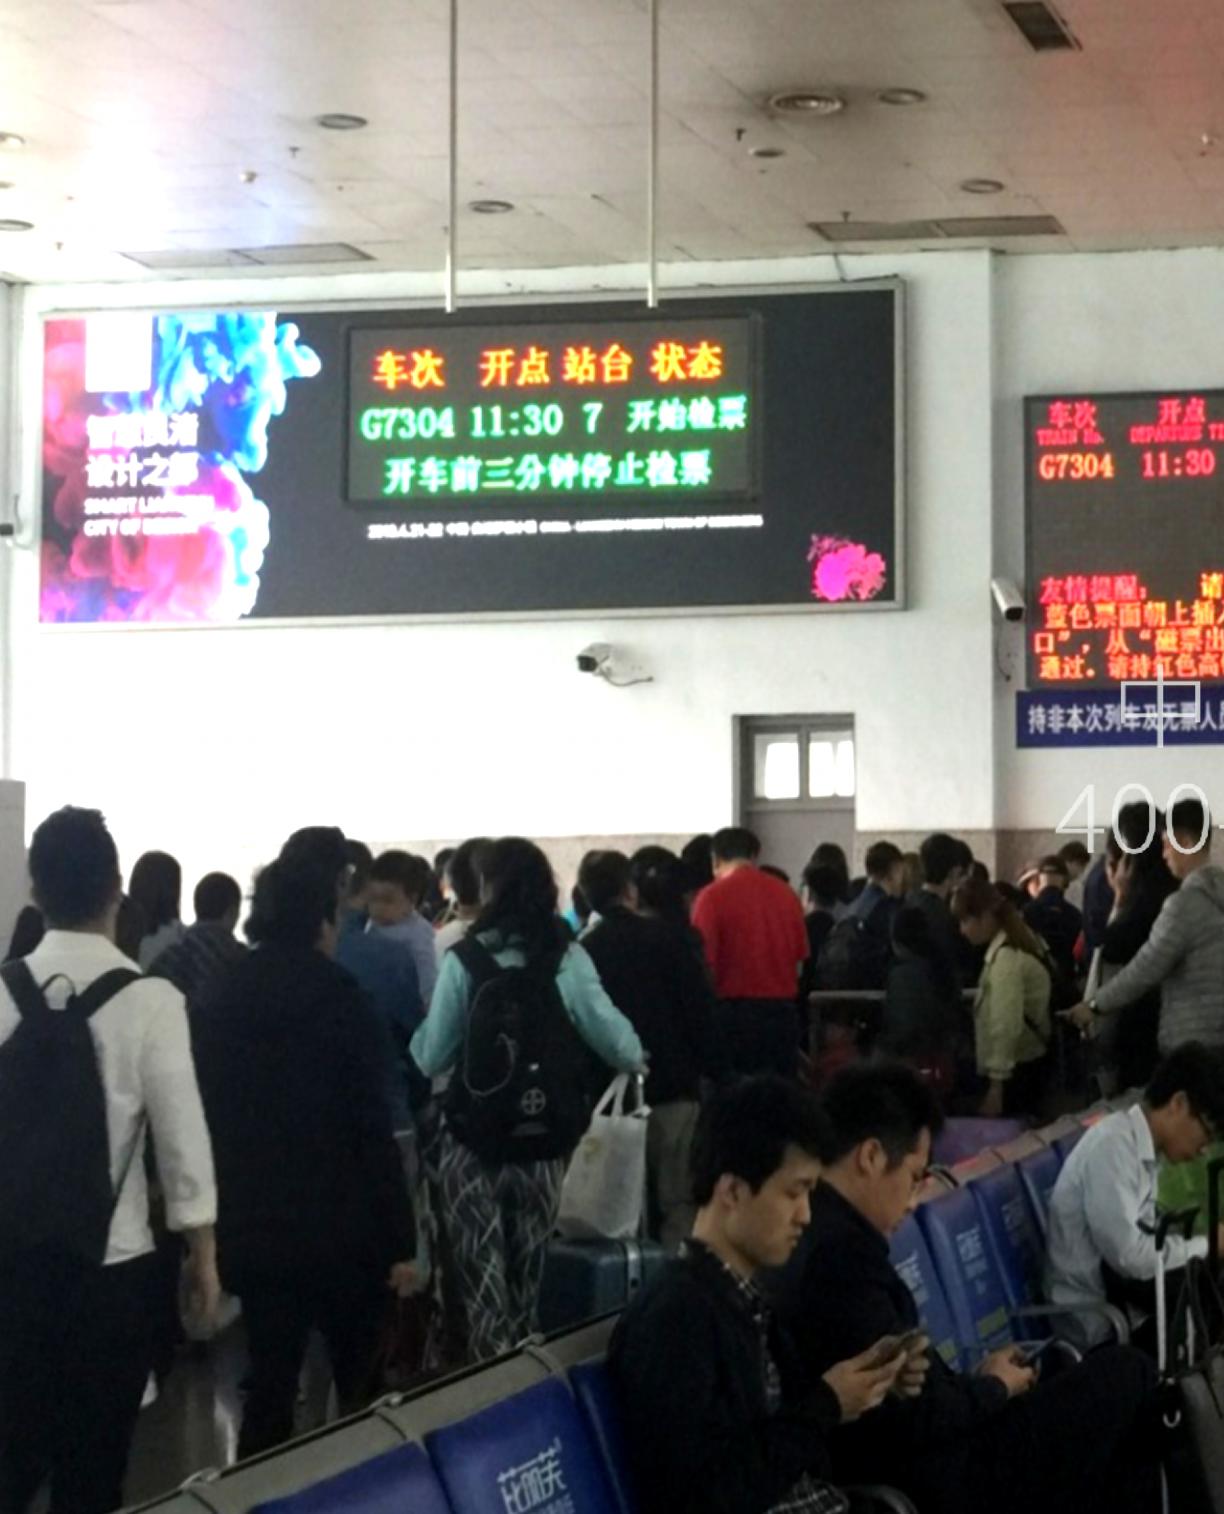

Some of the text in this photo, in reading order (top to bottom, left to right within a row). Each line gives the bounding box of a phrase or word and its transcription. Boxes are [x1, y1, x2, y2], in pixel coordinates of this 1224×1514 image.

[373, 341, 722, 390] 车次 开点 站台 状态
[361, 395, 748, 440] G7304 11:30 7 开始检票
[1050, 400, 1096, 428] 车次
[1159, 397, 1205, 425] 开点
[384, 449, 712, 494] 开车前三分钟停止检票
[1039, 453, 1114, 480] G7304
[1143, 449, 1215, 477] 11:30
